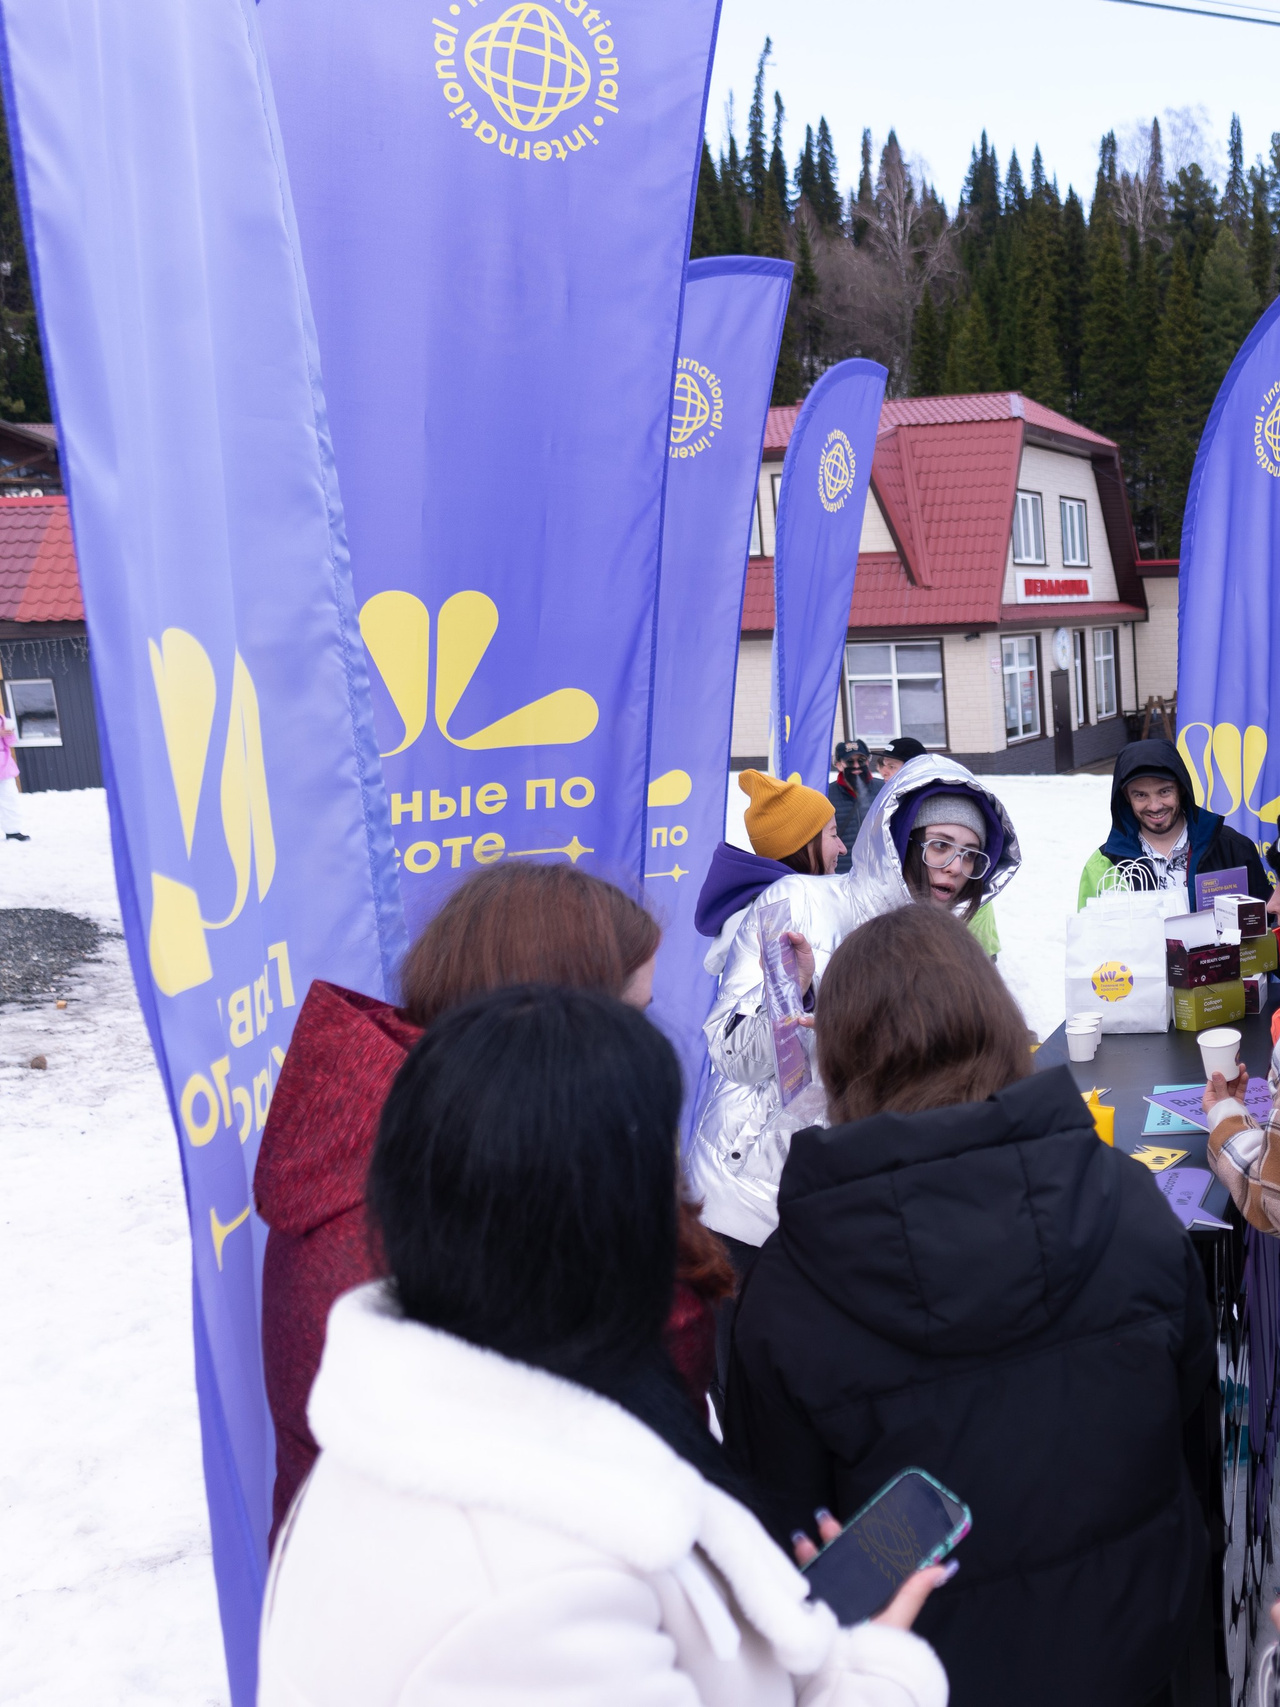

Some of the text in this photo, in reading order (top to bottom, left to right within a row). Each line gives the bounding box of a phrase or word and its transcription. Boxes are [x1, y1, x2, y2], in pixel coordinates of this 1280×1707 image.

[431, 18, 600, 162] international
[676, 357, 723, 430] rnational
[828, 429, 856, 494] international
[525, 776, 596, 811] по
[651, 825, 689, 848] по
